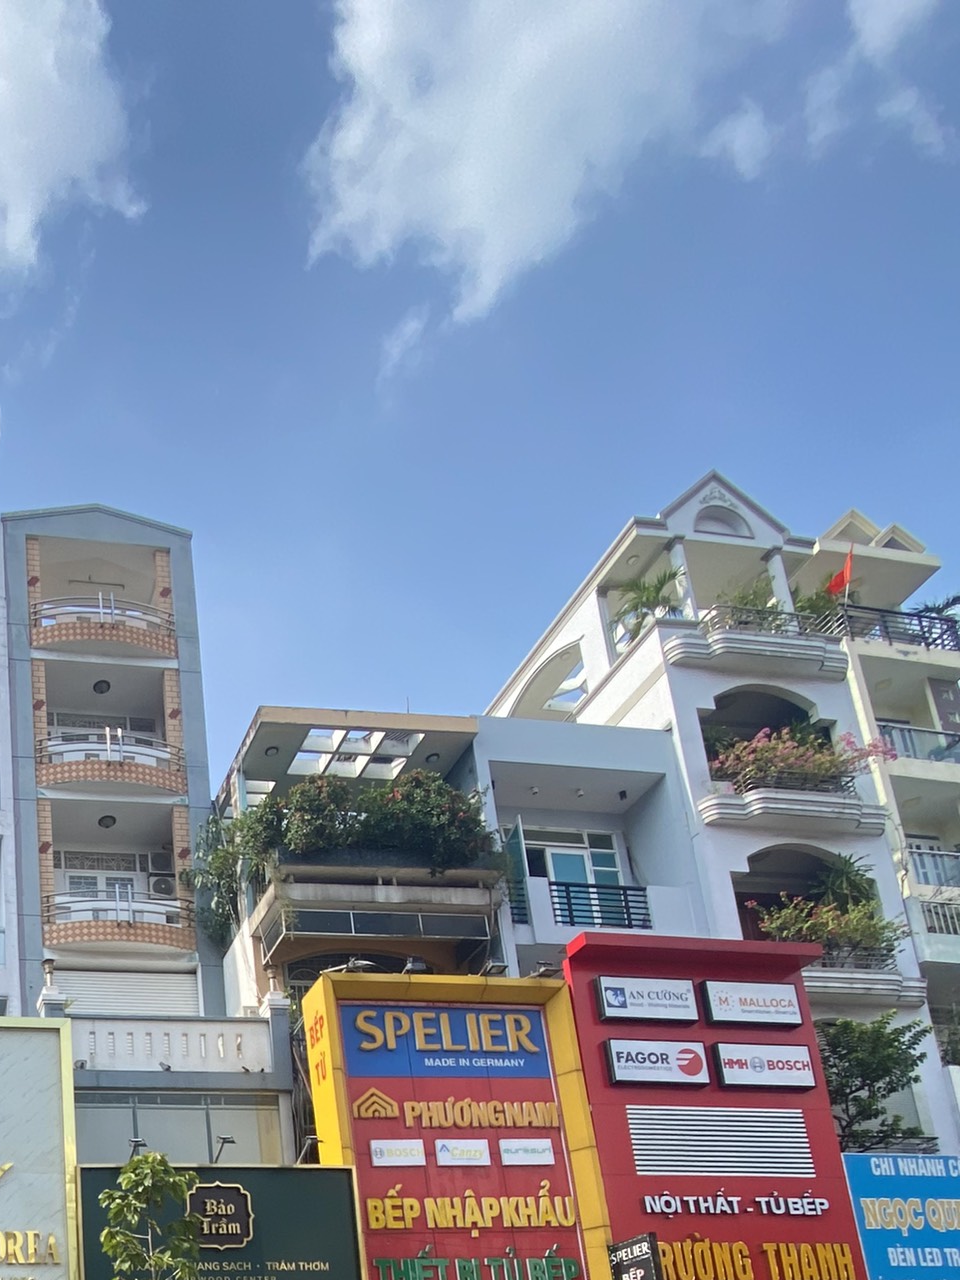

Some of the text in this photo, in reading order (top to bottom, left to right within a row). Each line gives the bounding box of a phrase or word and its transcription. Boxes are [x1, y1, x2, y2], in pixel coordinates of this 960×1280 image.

[628, 989, 689, 1002] AN CƯỜNG
[739, 997, 795, 1009] MALLOCA
[308, 1010, 325, 1050] BẾP
[355, 1009, 540, 1054] SPELIER
[424, 1056, 526, 1068] MADE IN GERMANY
[615, 1051, 671, 1065] FAGOR
[723, 1058, 811, 1072] HMH BOSCH
[315, 1051, 328, 1086] TỪ
[386, 1147, 423, 1157] BOSCH
[451, 1146, 485, 1159] Canzy
[870, 1155, 946, 1178] CHI NHÁNH
[204, 1198, 236, 1216] Bảo
[367, 1178, 576, 1238] BẾP NHẬP KHẨU
[643, 1187, 830, 1219] NỘI THẤT TỦ BẾP
[860, 1197, 925, 1237] NGỌC
[610, 1241, 652, 1265] SPELIER
[887, 1243, 941, 1267] ĐÈN LED
[222, 1261, 252, 1273] SẠCH
[298, 1260, 330, 1271] THƠM
